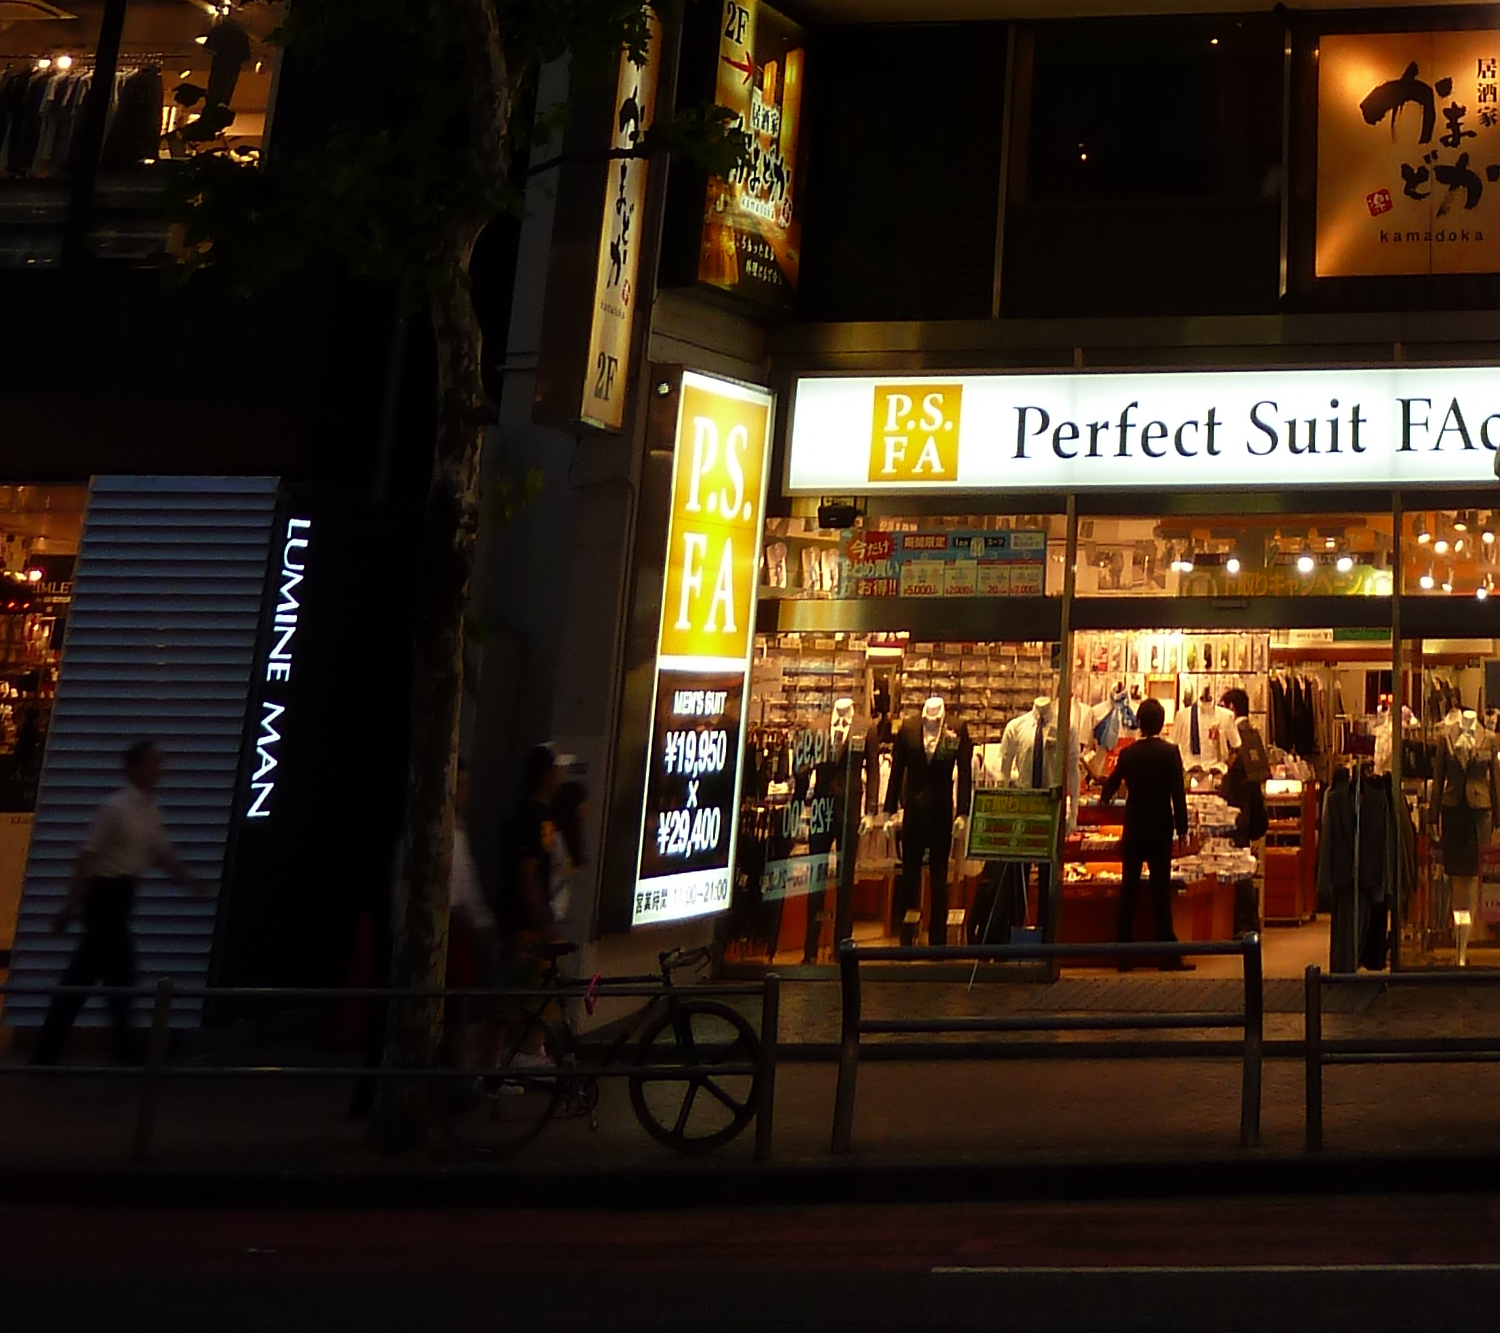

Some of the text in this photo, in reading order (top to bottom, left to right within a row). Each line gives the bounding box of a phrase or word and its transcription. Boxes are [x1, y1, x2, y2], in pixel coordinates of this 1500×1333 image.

[724, 0, 751, 47] 2F
[1475, 57, 1499, 128] 居酒家
[1379, 228, 1487, 244] kamadoka
[594, 350, 618, 403] 2F
[883, 392, 953, 431] P.S.
[1011, 398, 1222, 461] Perfect
[1246, 397, 1368, 457] Suit
[685, 415, 753, 523] P.S.
[244, 516, 313, 820] LUMINE MAN
[673, 689, 728, 716] MEN'S SUIT
[664, 729, 728, 775] ¥19,950
[656, 806, 721, 858] ¥29,400
